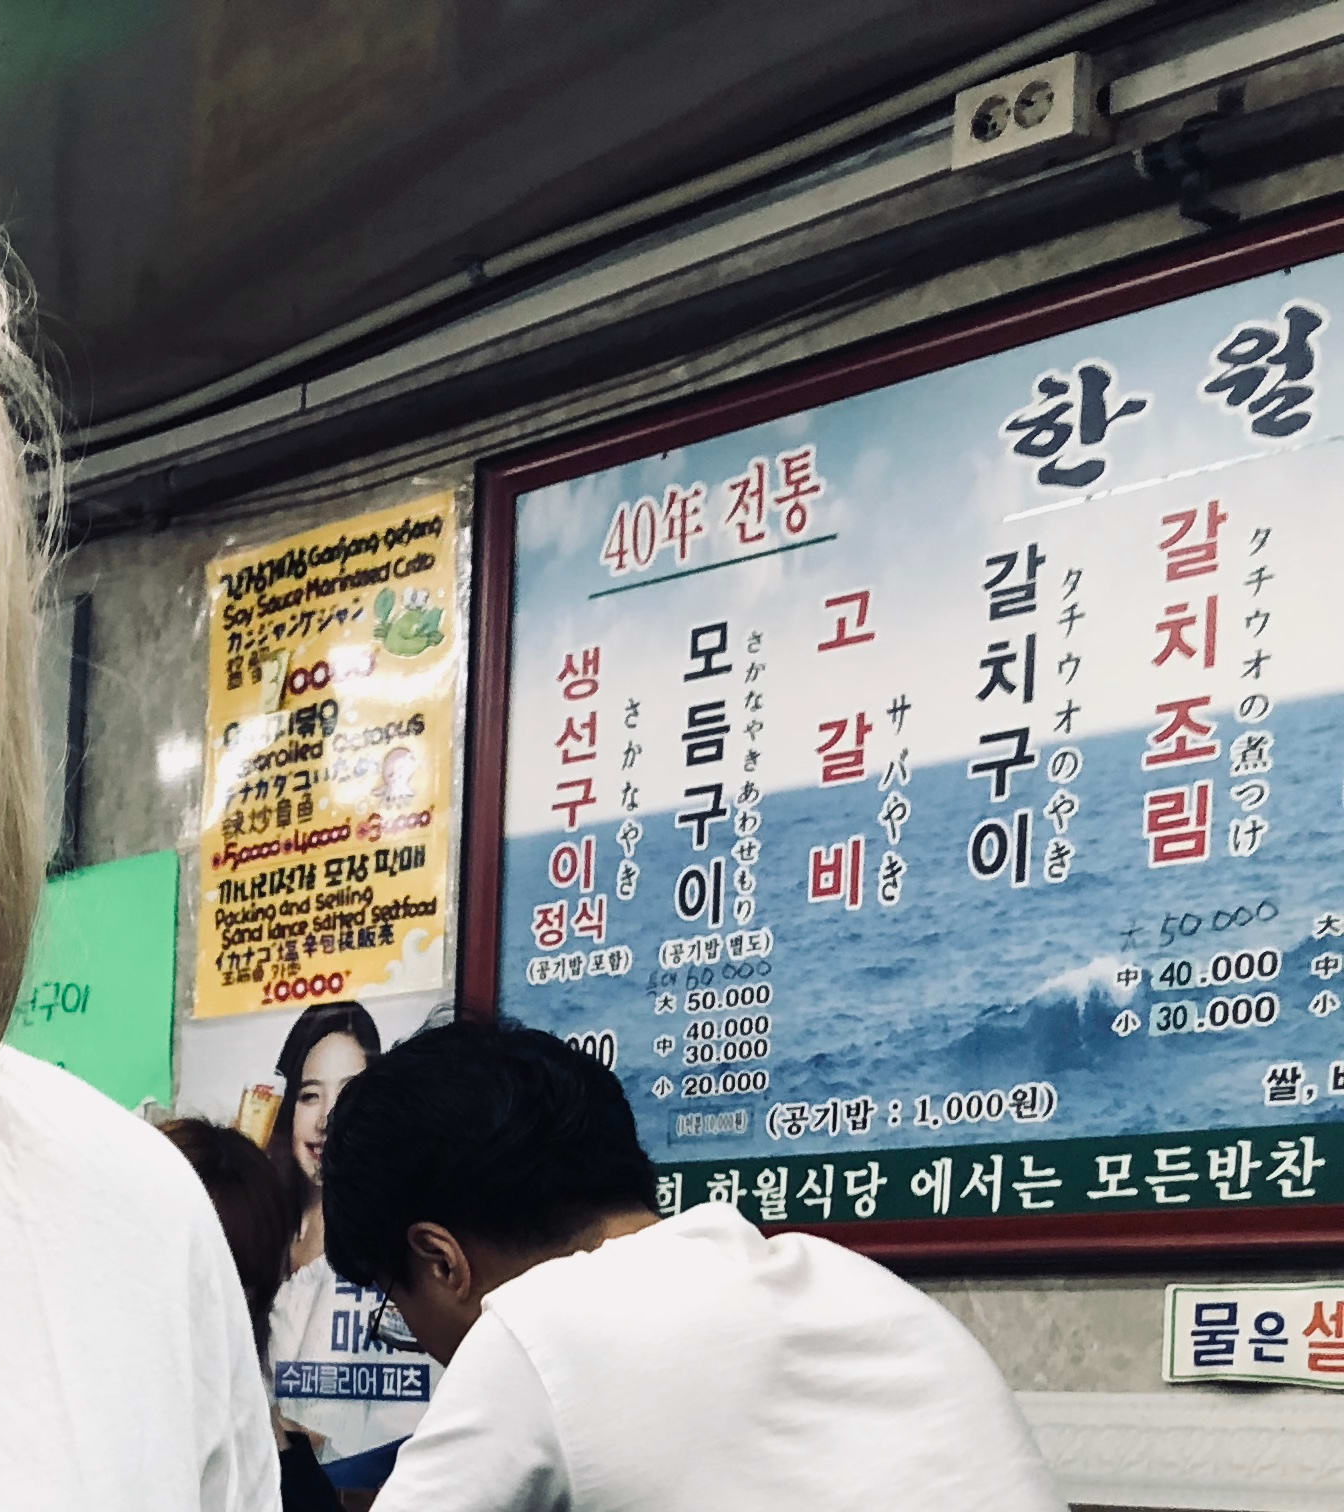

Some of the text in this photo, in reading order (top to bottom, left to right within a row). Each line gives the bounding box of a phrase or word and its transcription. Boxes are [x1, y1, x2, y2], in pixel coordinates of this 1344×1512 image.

[602, 449, 822, 571] 40年 전통
[1145, 498, 1229, 865] 갈치조림
[971, 542, 1048, 883] 갈치구이
[811, 589, 876, 906] 고갈비
[551, 646, 601, 889] 생선구이
[677, 621, 733, 925] 모듬구이
[619, 697, 643, 896] さかなやき
[881, 693, 912, 902] サバやき
[280, 896, 310, 915] and
[535, 898, 603, 947] 정식
[1317, 914, 1342, 935] 大
[528, 949, 630, 983] (공기밥 포함)
[661, 930, 772, 966] (공기밥 별도)
[1315, 956, 1339, 976] 中
[1117, 950, 1278, 987] 中 40.000
[657, 984, 771, 1012] 大 50.000
[1116, 996, 1275, 1033] 小 30.000
[1313, 994, 1337, 1014] 小
[686, 1015, 770, 1041] 40.000
[657, 1037, 769, 1064] 中 30.000
[654, 1072, 767, 1096] 小 20.000
[769, 1101, 873, 1138] (공기밥
[916, 1083, 1056, 1128] 1.000원)
[911, 1154, 1063, 1215] 에서는
[1087, 1136, 1326, 1204] 모든반찬
[1191, 1302, 1289, 1367] 물은
[281, 1364, 422, 1397] 수퍼클리어 피츠
